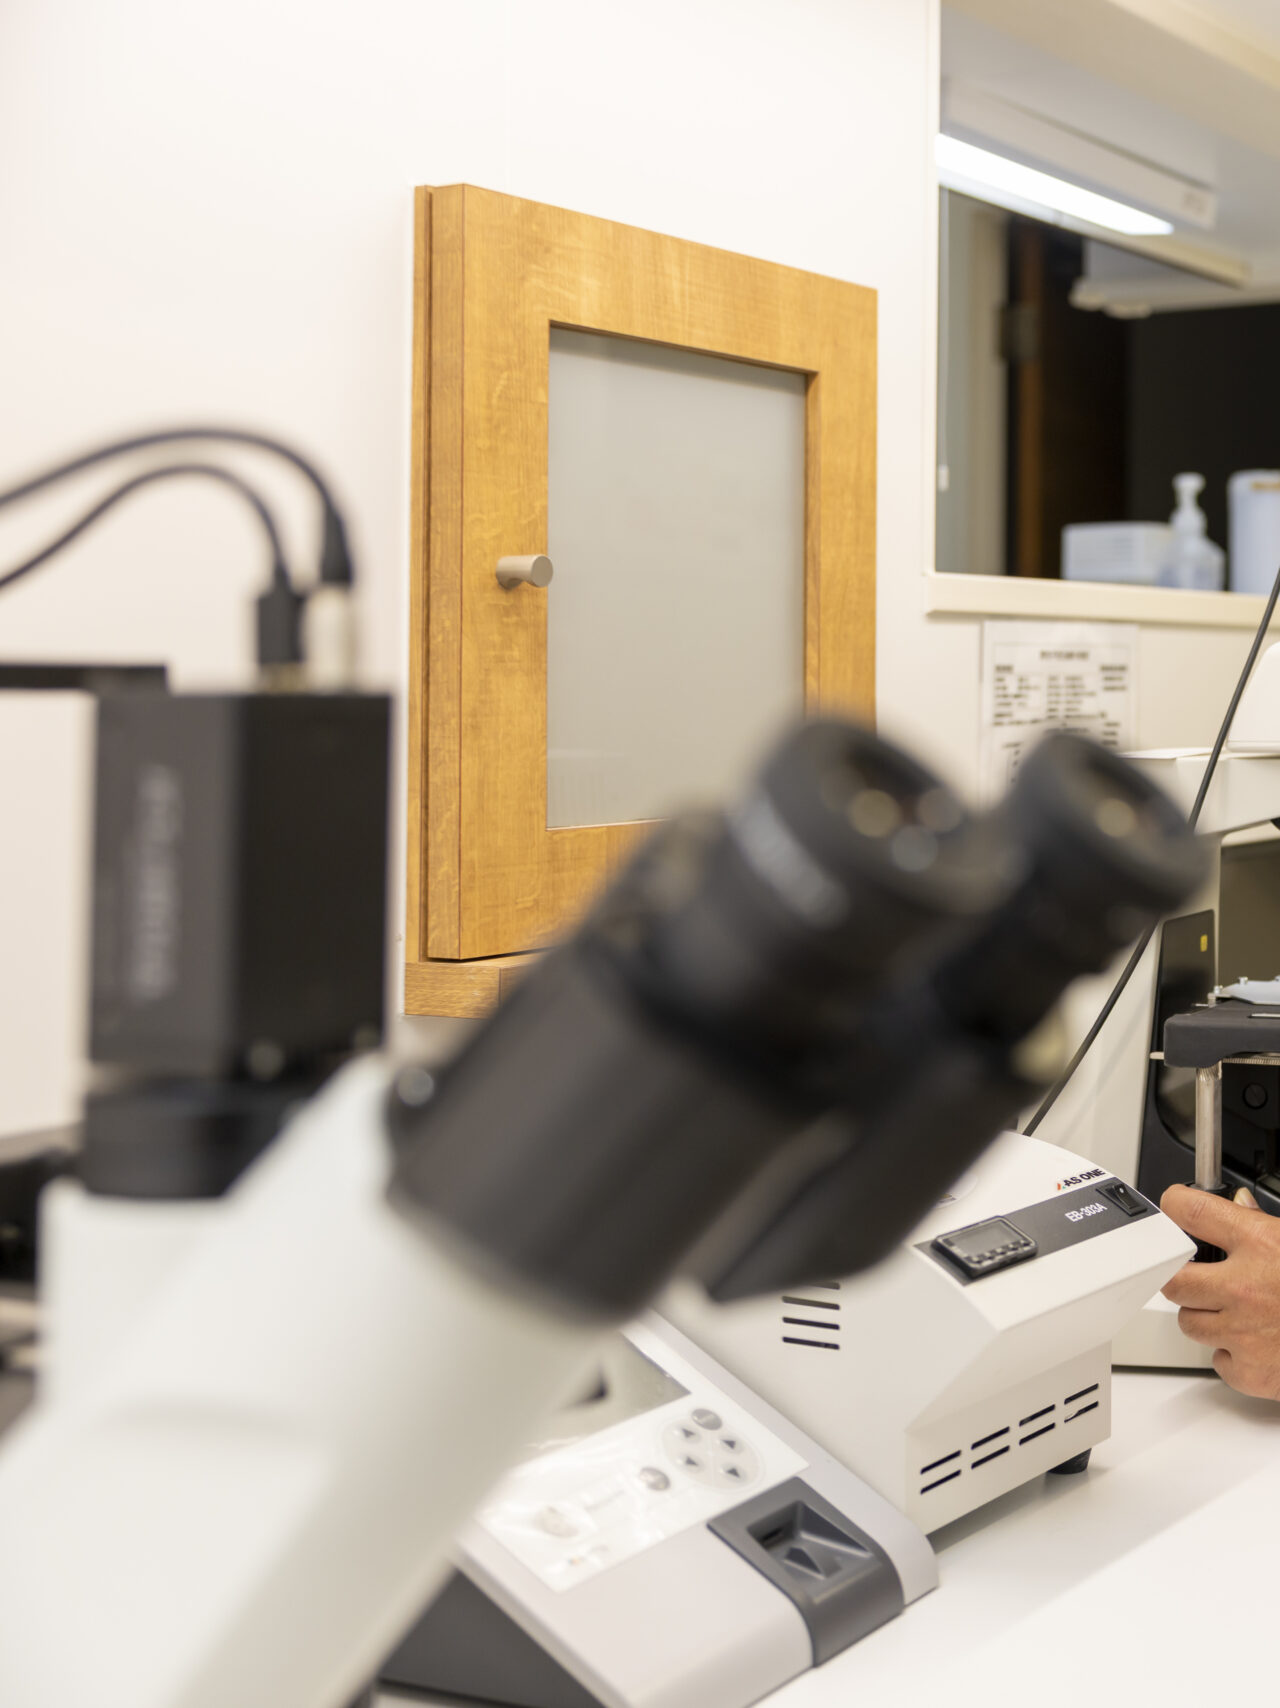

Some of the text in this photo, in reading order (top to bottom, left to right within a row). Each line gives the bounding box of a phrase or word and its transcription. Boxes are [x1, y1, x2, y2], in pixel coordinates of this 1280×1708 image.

[1063, 1168, 1106, 1187] AS ONE
[1065, 1202, 1108, 1222] EB-303A
